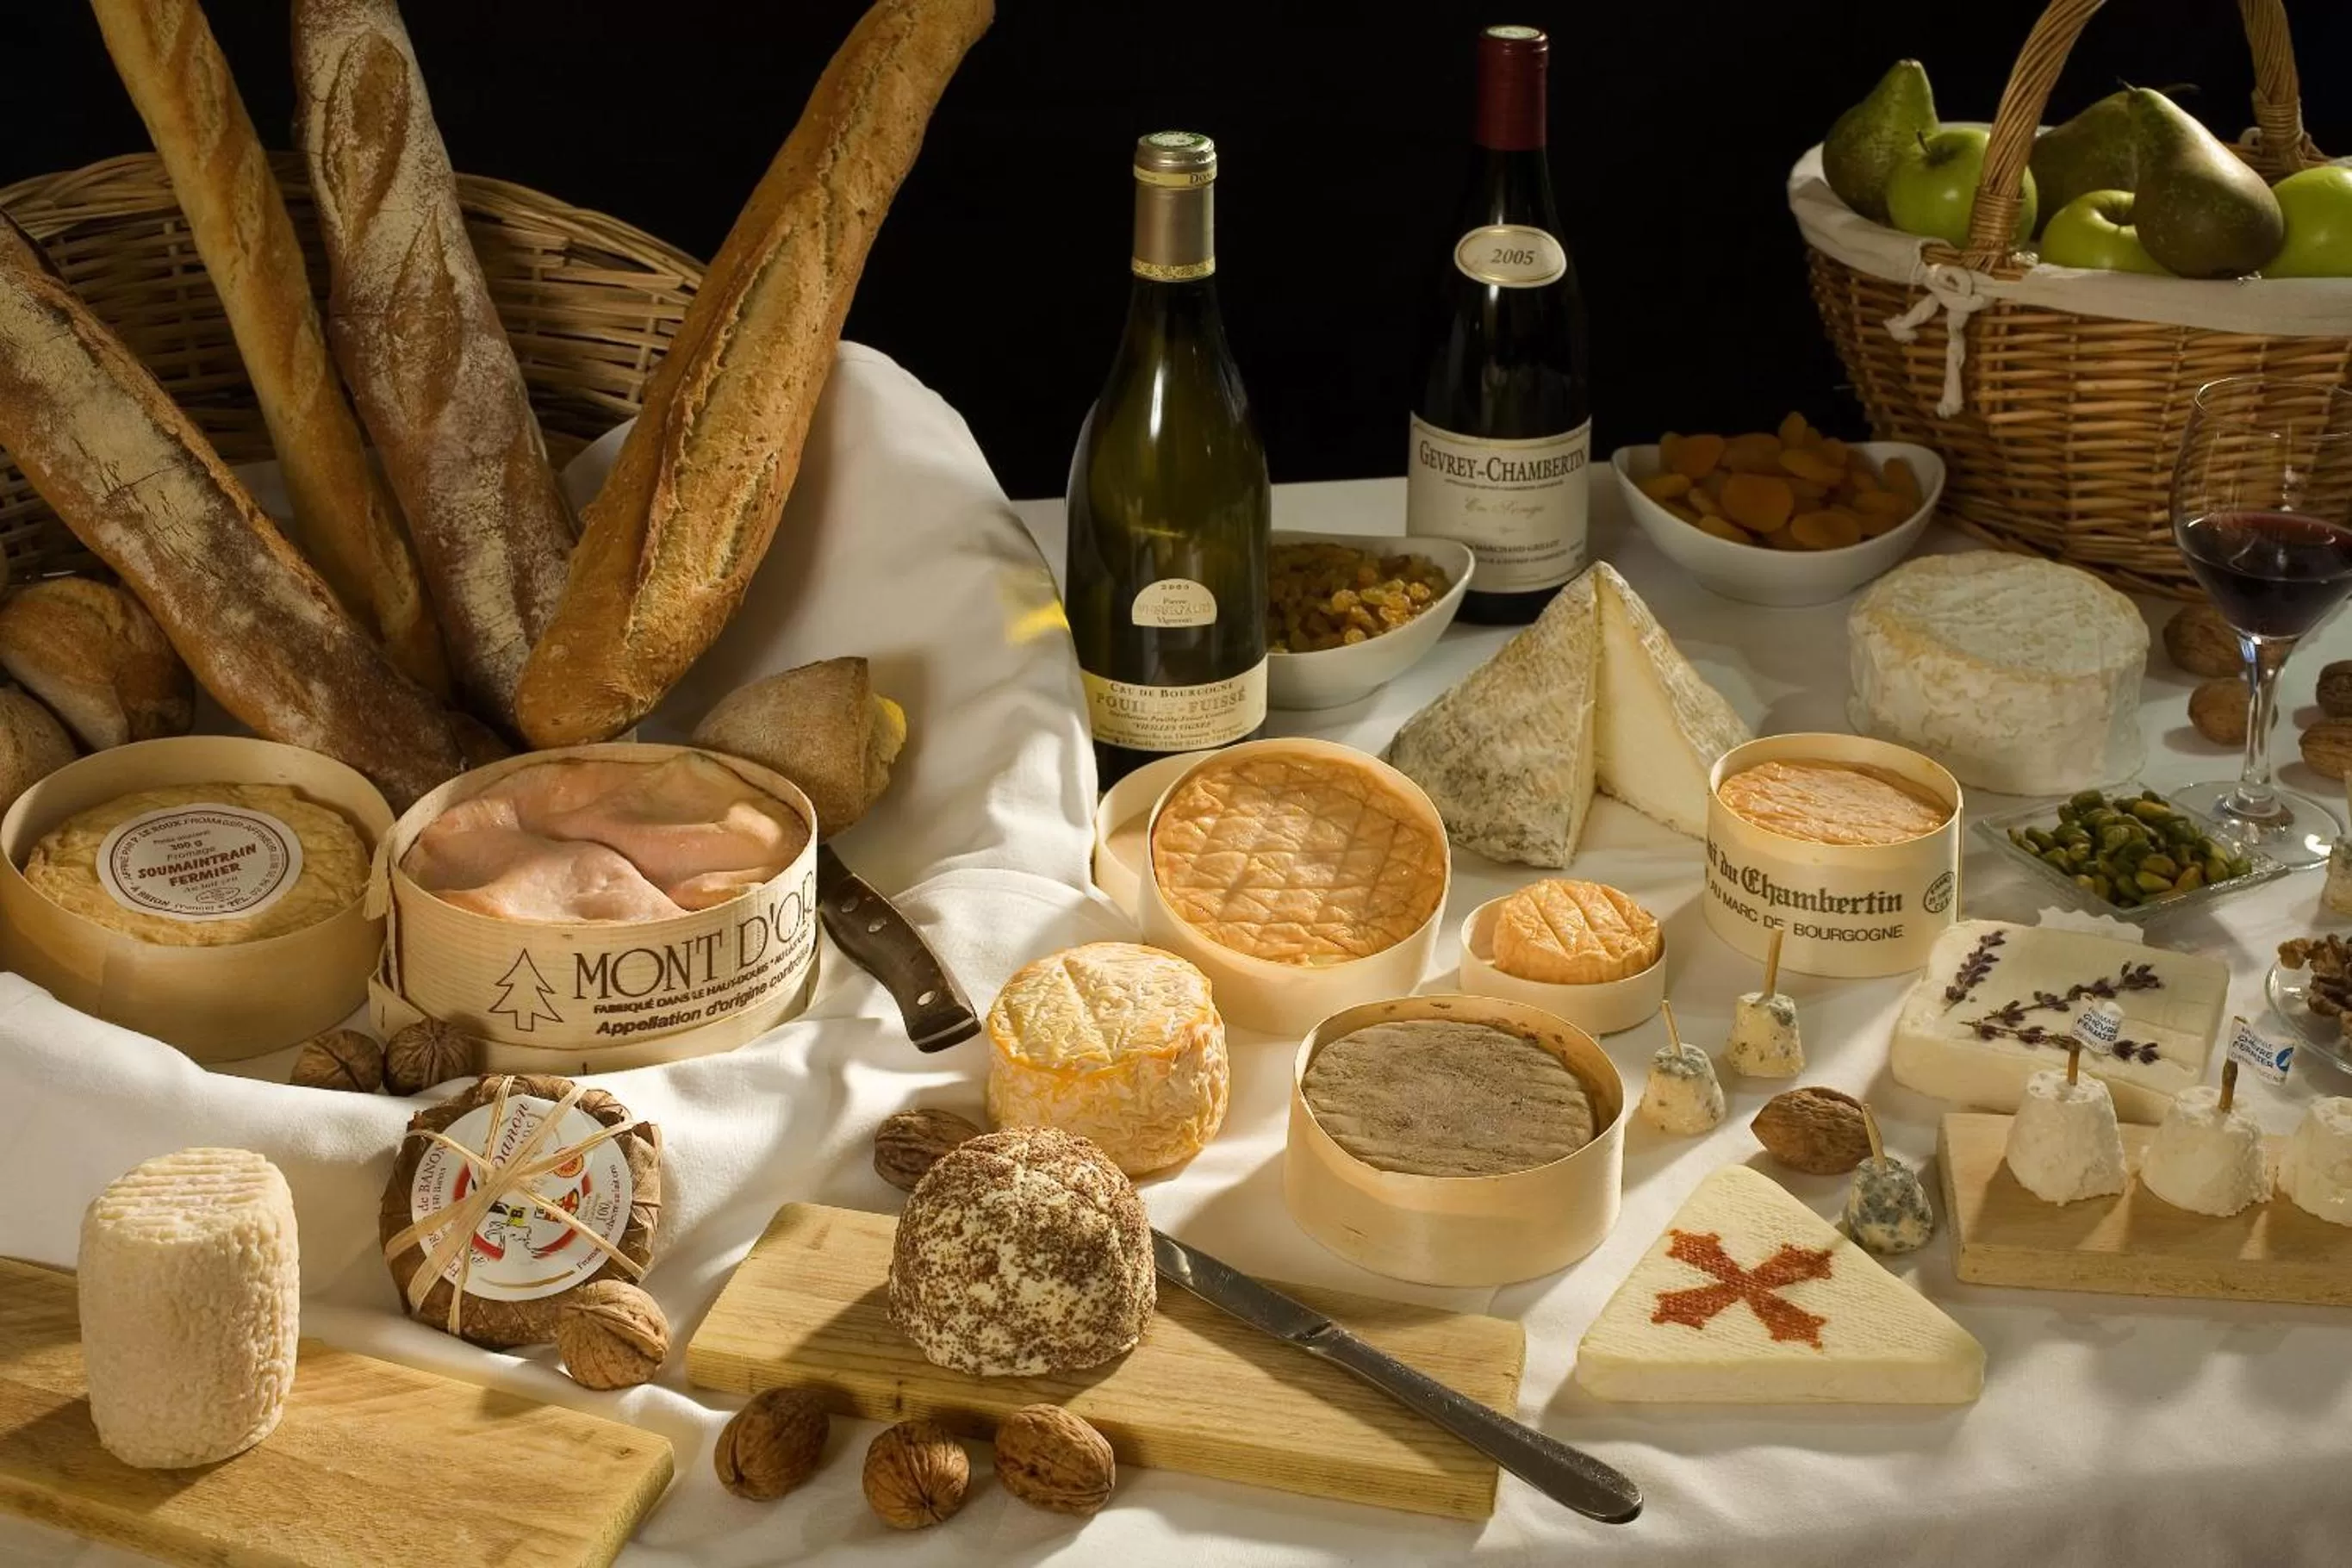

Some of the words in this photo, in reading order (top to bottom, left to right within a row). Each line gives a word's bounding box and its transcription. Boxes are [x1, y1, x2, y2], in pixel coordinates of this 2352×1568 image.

[1490, 248, 1535, 266] 2005
[1420, 440, 1585, 482] GEVREY-CHAMBERTIN
[138, 843, 257, 879] SOUMAINTRAIN
[169, 862, 241, 887] FERMIER
[1720, 851, 1739, 886] du
[1741, 866, 1903, 914] Chambertin
[1710, 879, 1721, 899] AU
[1723, 892, 1758, 923] MARC
[1763, 914, 1786, 929] DE
[1793, 923, 1905, 943] BOURGOGNE
[573, 928, 723, 999] MONT
[737, 870, 814, 971] D'OR
[593, 998, 655, 1014] FABRIQUÉ
[656, 993, 690, 1008] DANS
[692, 988, 706, 999] LE
[595, 1009, 701, 1036] Appellation
[705, 980, 768, 1016] d'origine
[419, 1142, 447, 1192] BANON
[417, 1197, 429, 1211] de
